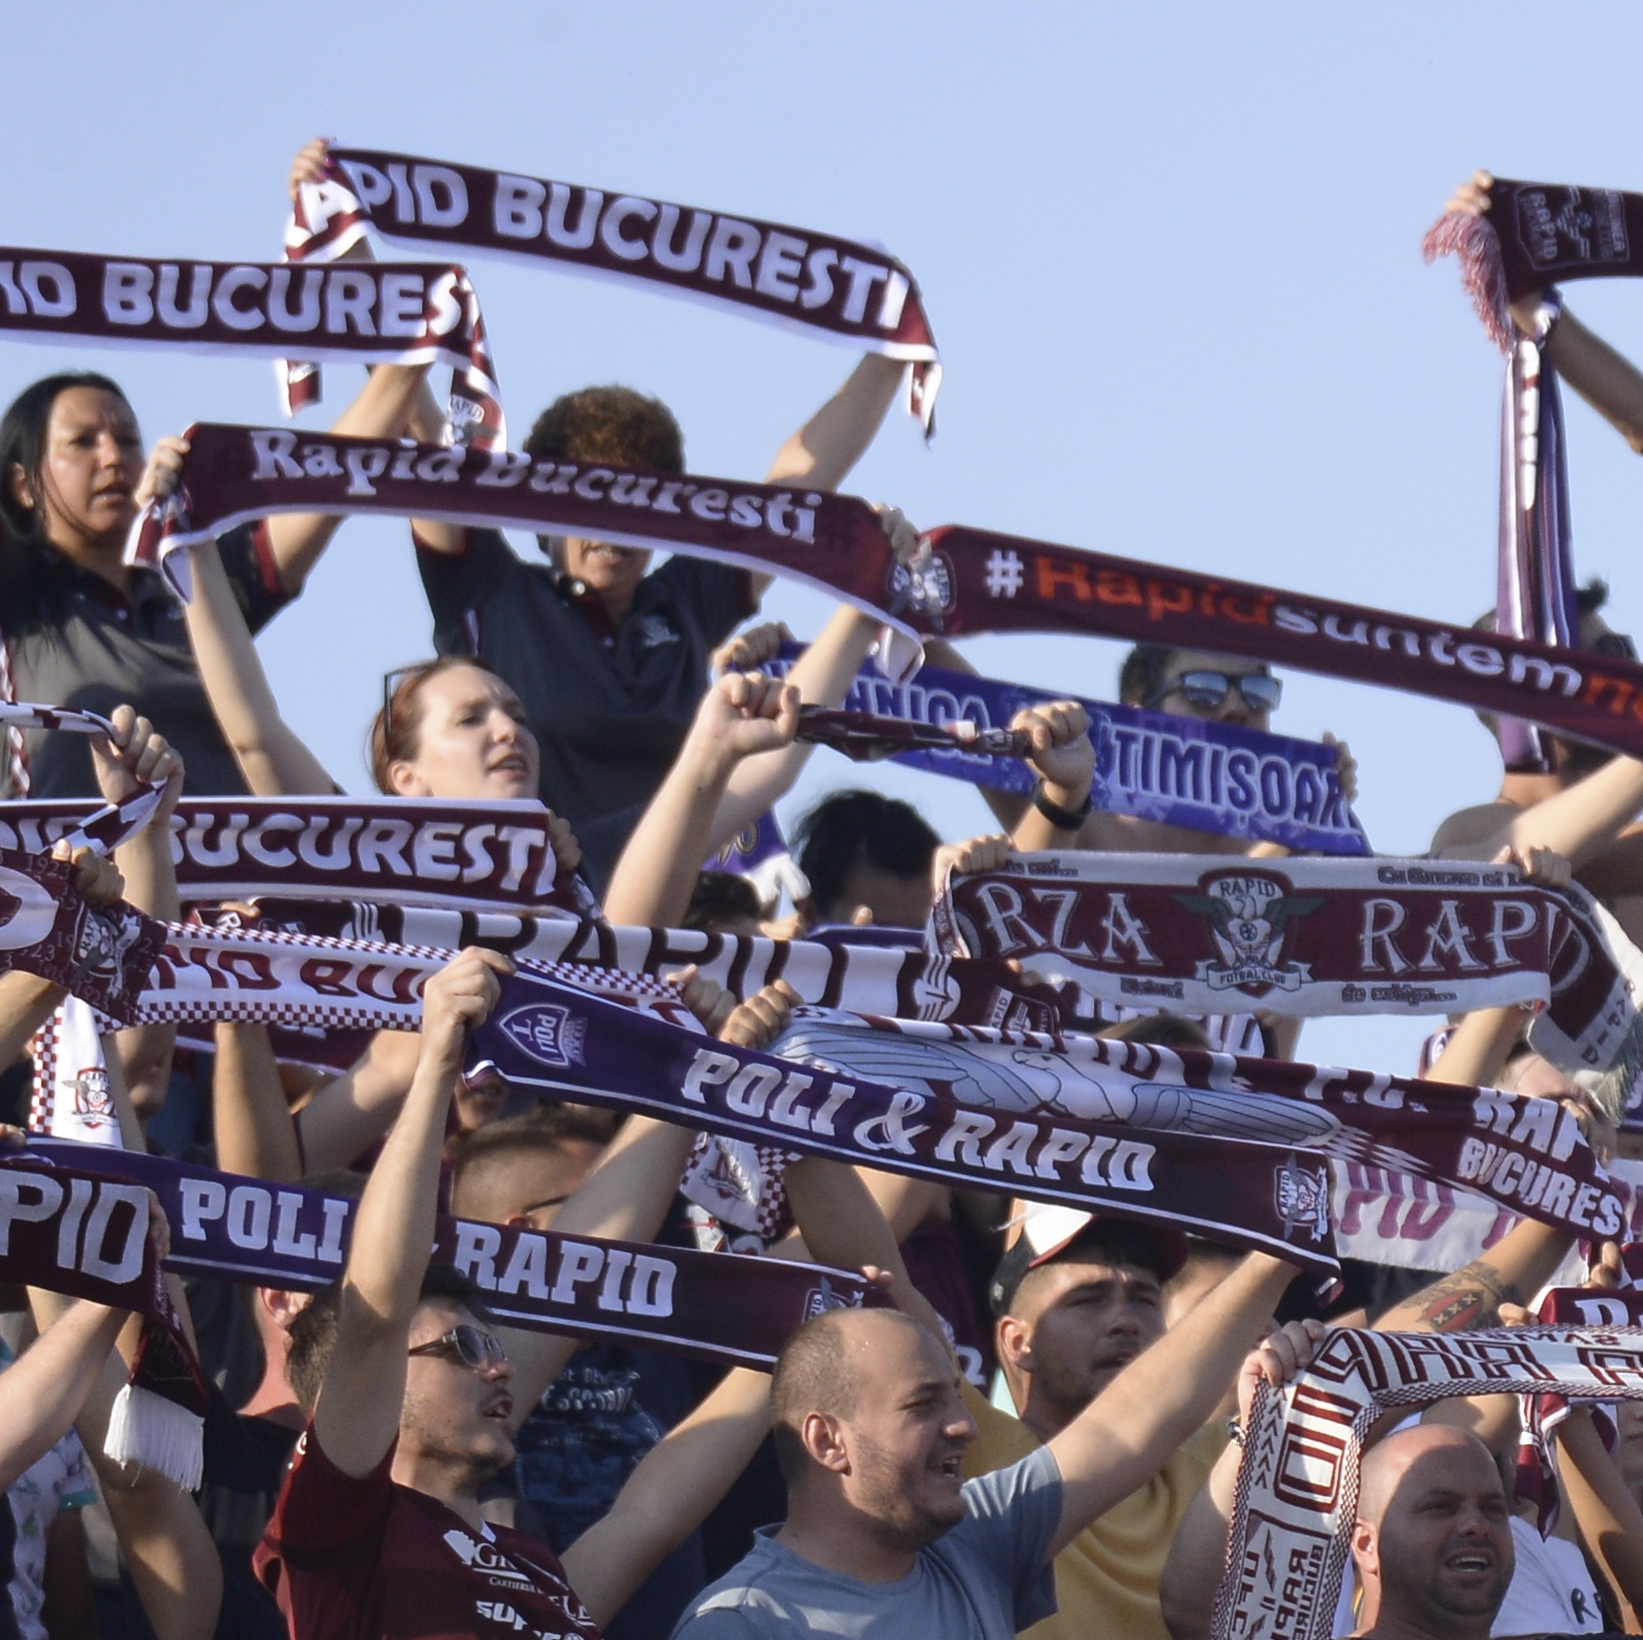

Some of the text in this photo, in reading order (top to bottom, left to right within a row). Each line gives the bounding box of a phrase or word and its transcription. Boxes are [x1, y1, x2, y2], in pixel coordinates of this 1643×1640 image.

[300, 160, 912, 328] APID BUCURESTI
[104, 262, 468, 338] BUCURES
[249, 428, 822, 546] Rapid Bucuresti
[172, 812, 556, 897] UCURESTI
[1219, 879, 1277, 897] RAPID
[976, 882, 1165, 967] RZA
[682, 1048, 1157, 1193] POLI & RAPID
[1473, 1085, 1590, 1163] RAP
[1457, 1136, 1625, 1237] BUCURES
[0, 1167, 679, 1319] PID POLI RAPID
